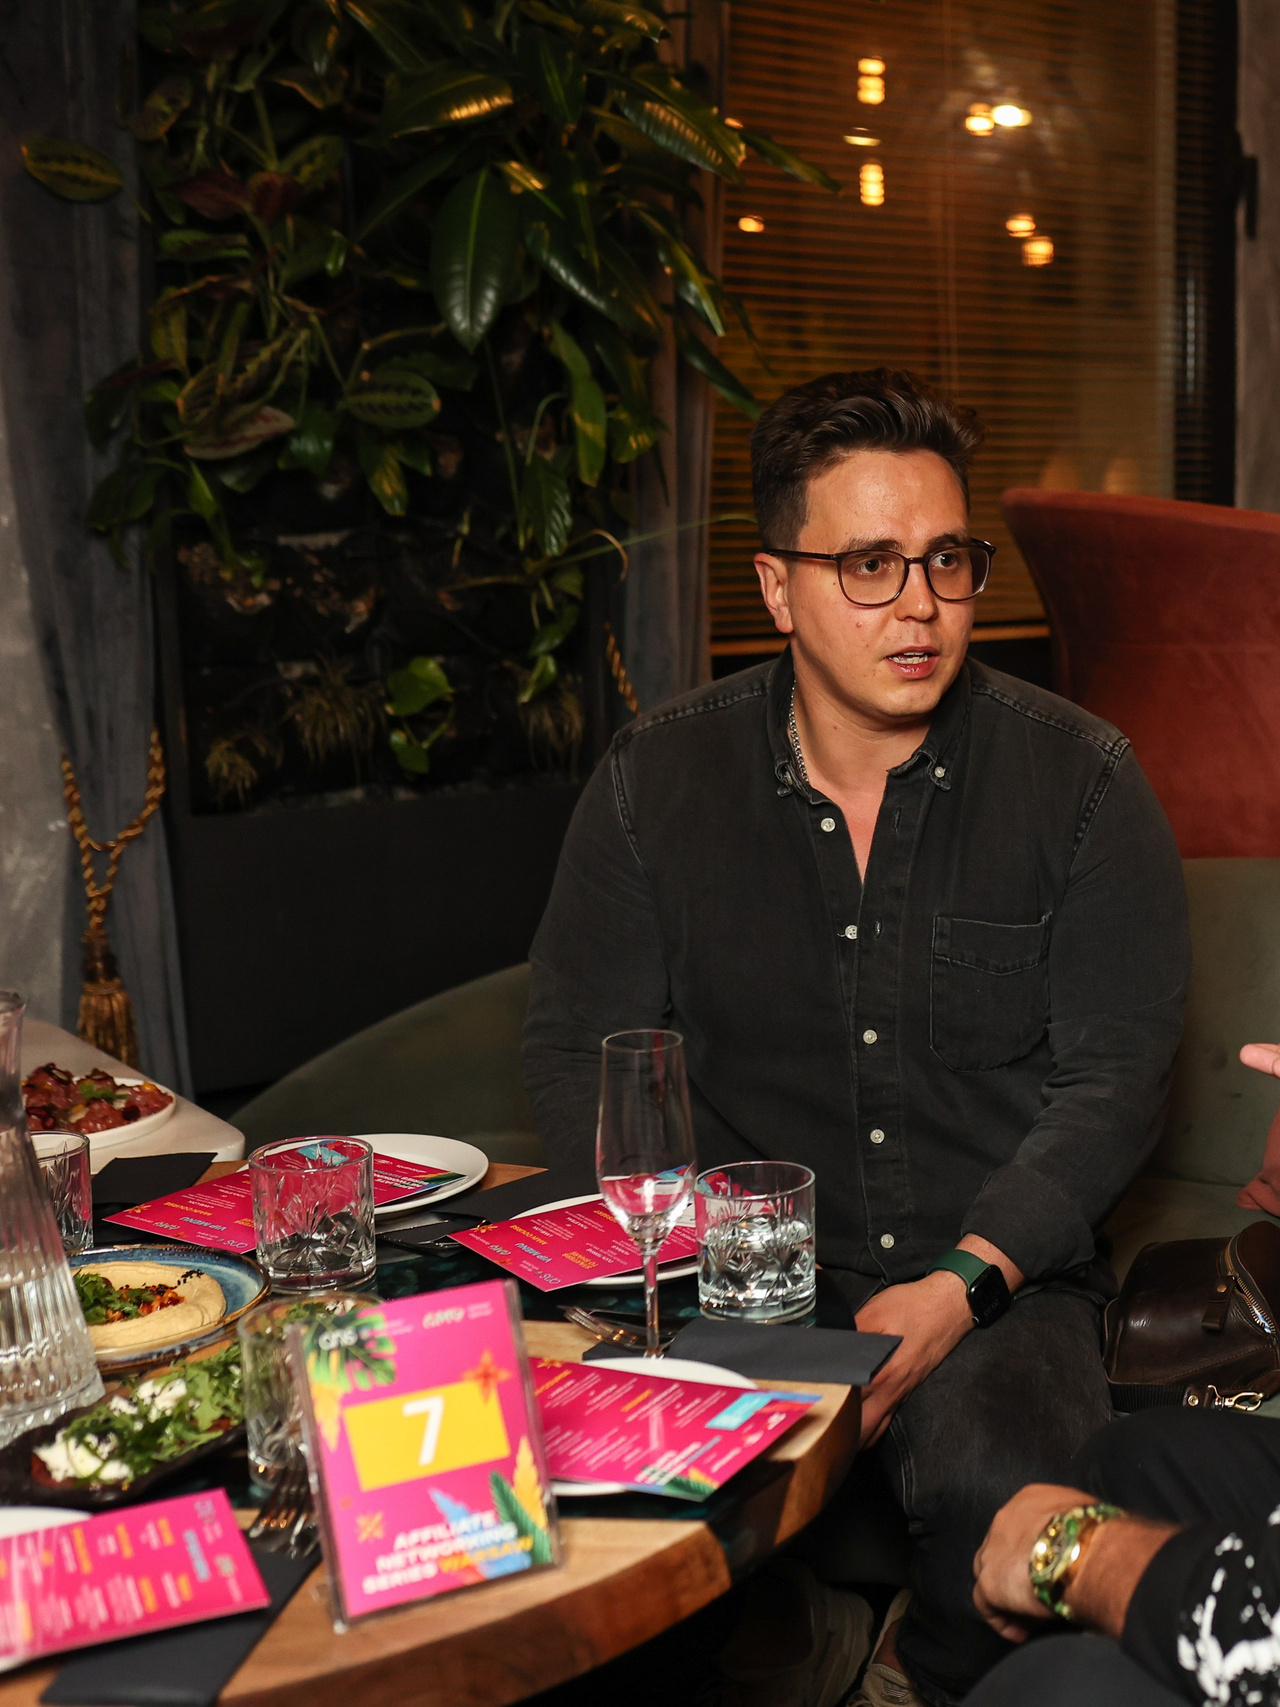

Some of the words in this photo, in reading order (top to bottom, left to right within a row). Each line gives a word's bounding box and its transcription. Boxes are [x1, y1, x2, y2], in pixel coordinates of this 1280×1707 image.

[179, 1216, 211, 1227] MENU
[514, 1242, 538, 1258] MENU
[537, 1252, 553, 1263] VIP
[401, 1395, 445, 1466] 7
[394, 1510, 497, 1551] AFFILIATE
[362, 1561, 438, 1595] SERIES
